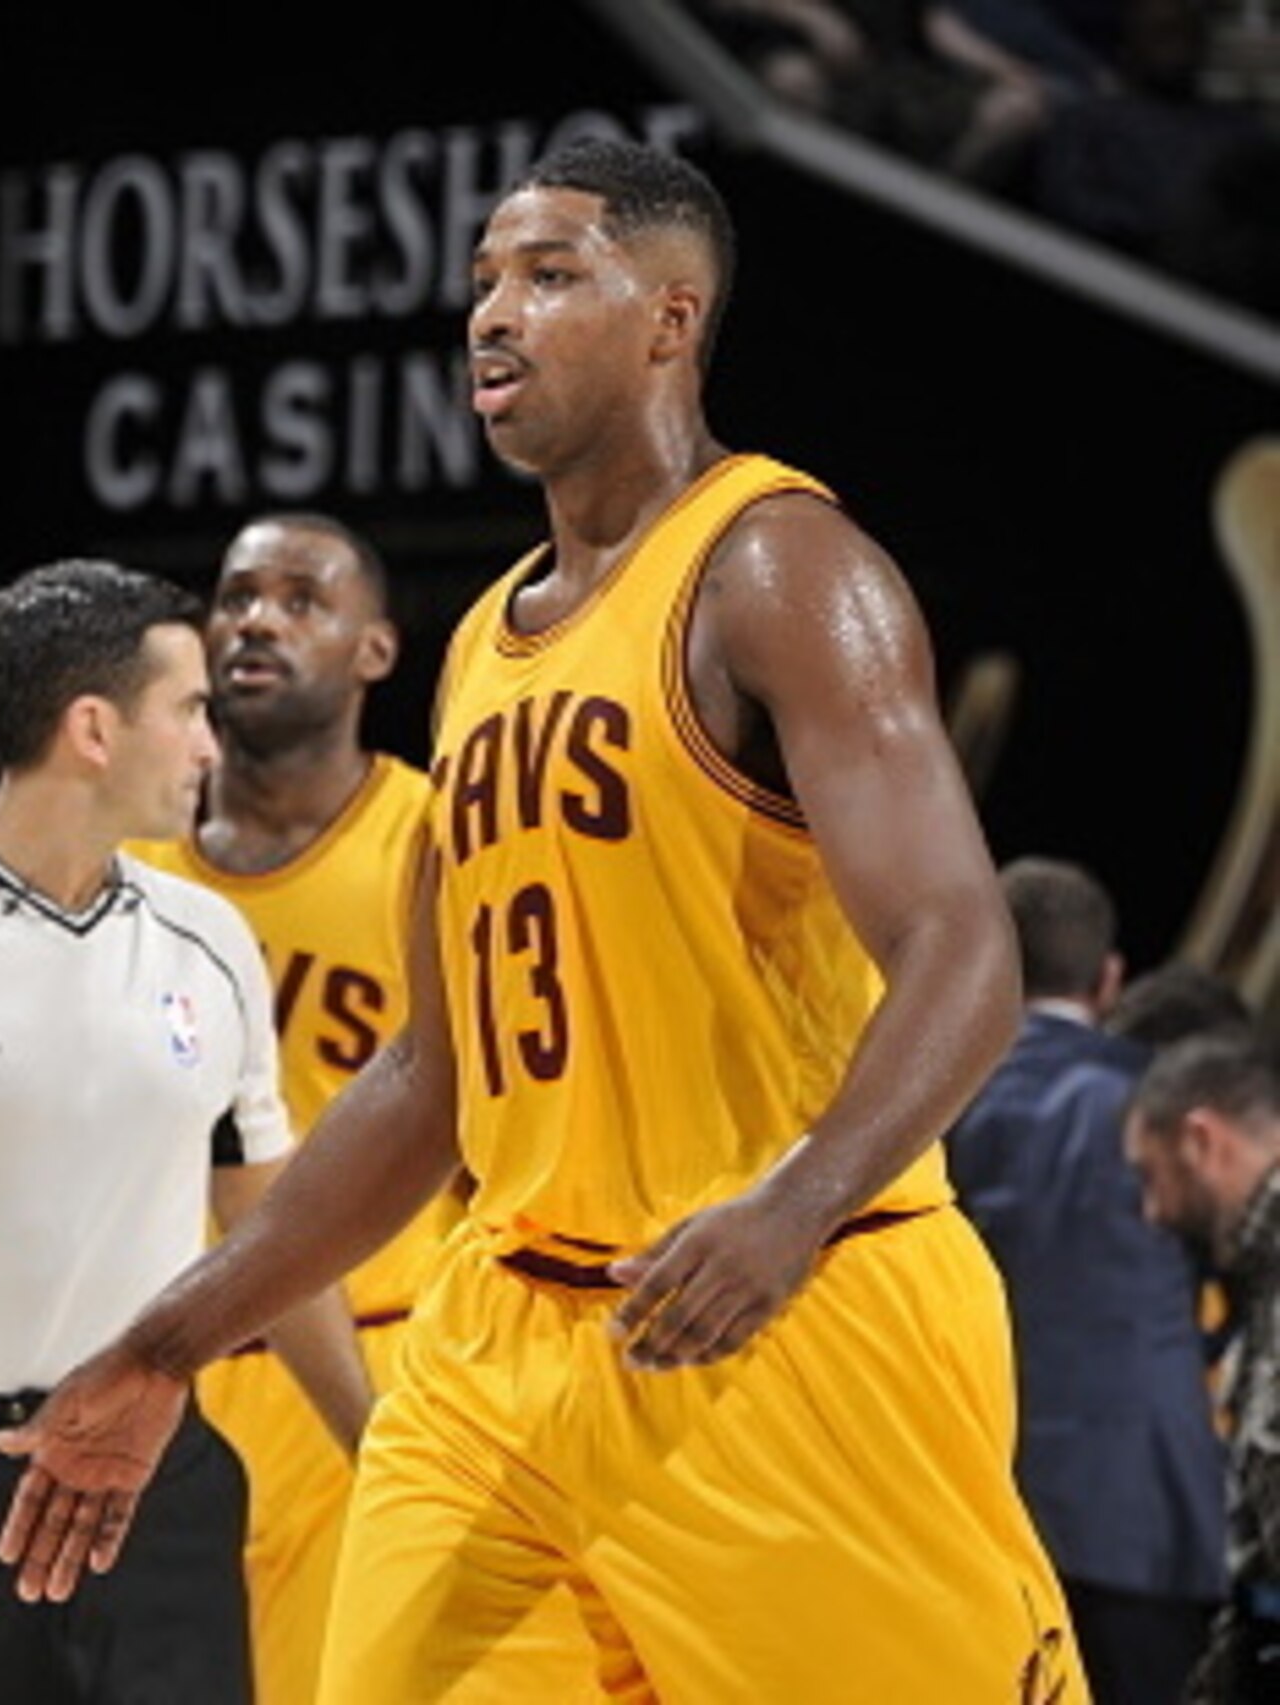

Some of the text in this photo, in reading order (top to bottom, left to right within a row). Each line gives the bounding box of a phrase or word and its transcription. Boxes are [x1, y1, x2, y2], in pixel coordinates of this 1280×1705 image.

[85, 350, 478, 508] CASIN
[431, 691, 630, 866] AVS
[260, 942, 386, 1074] VS
[471, 883, 568, 1097] 13
